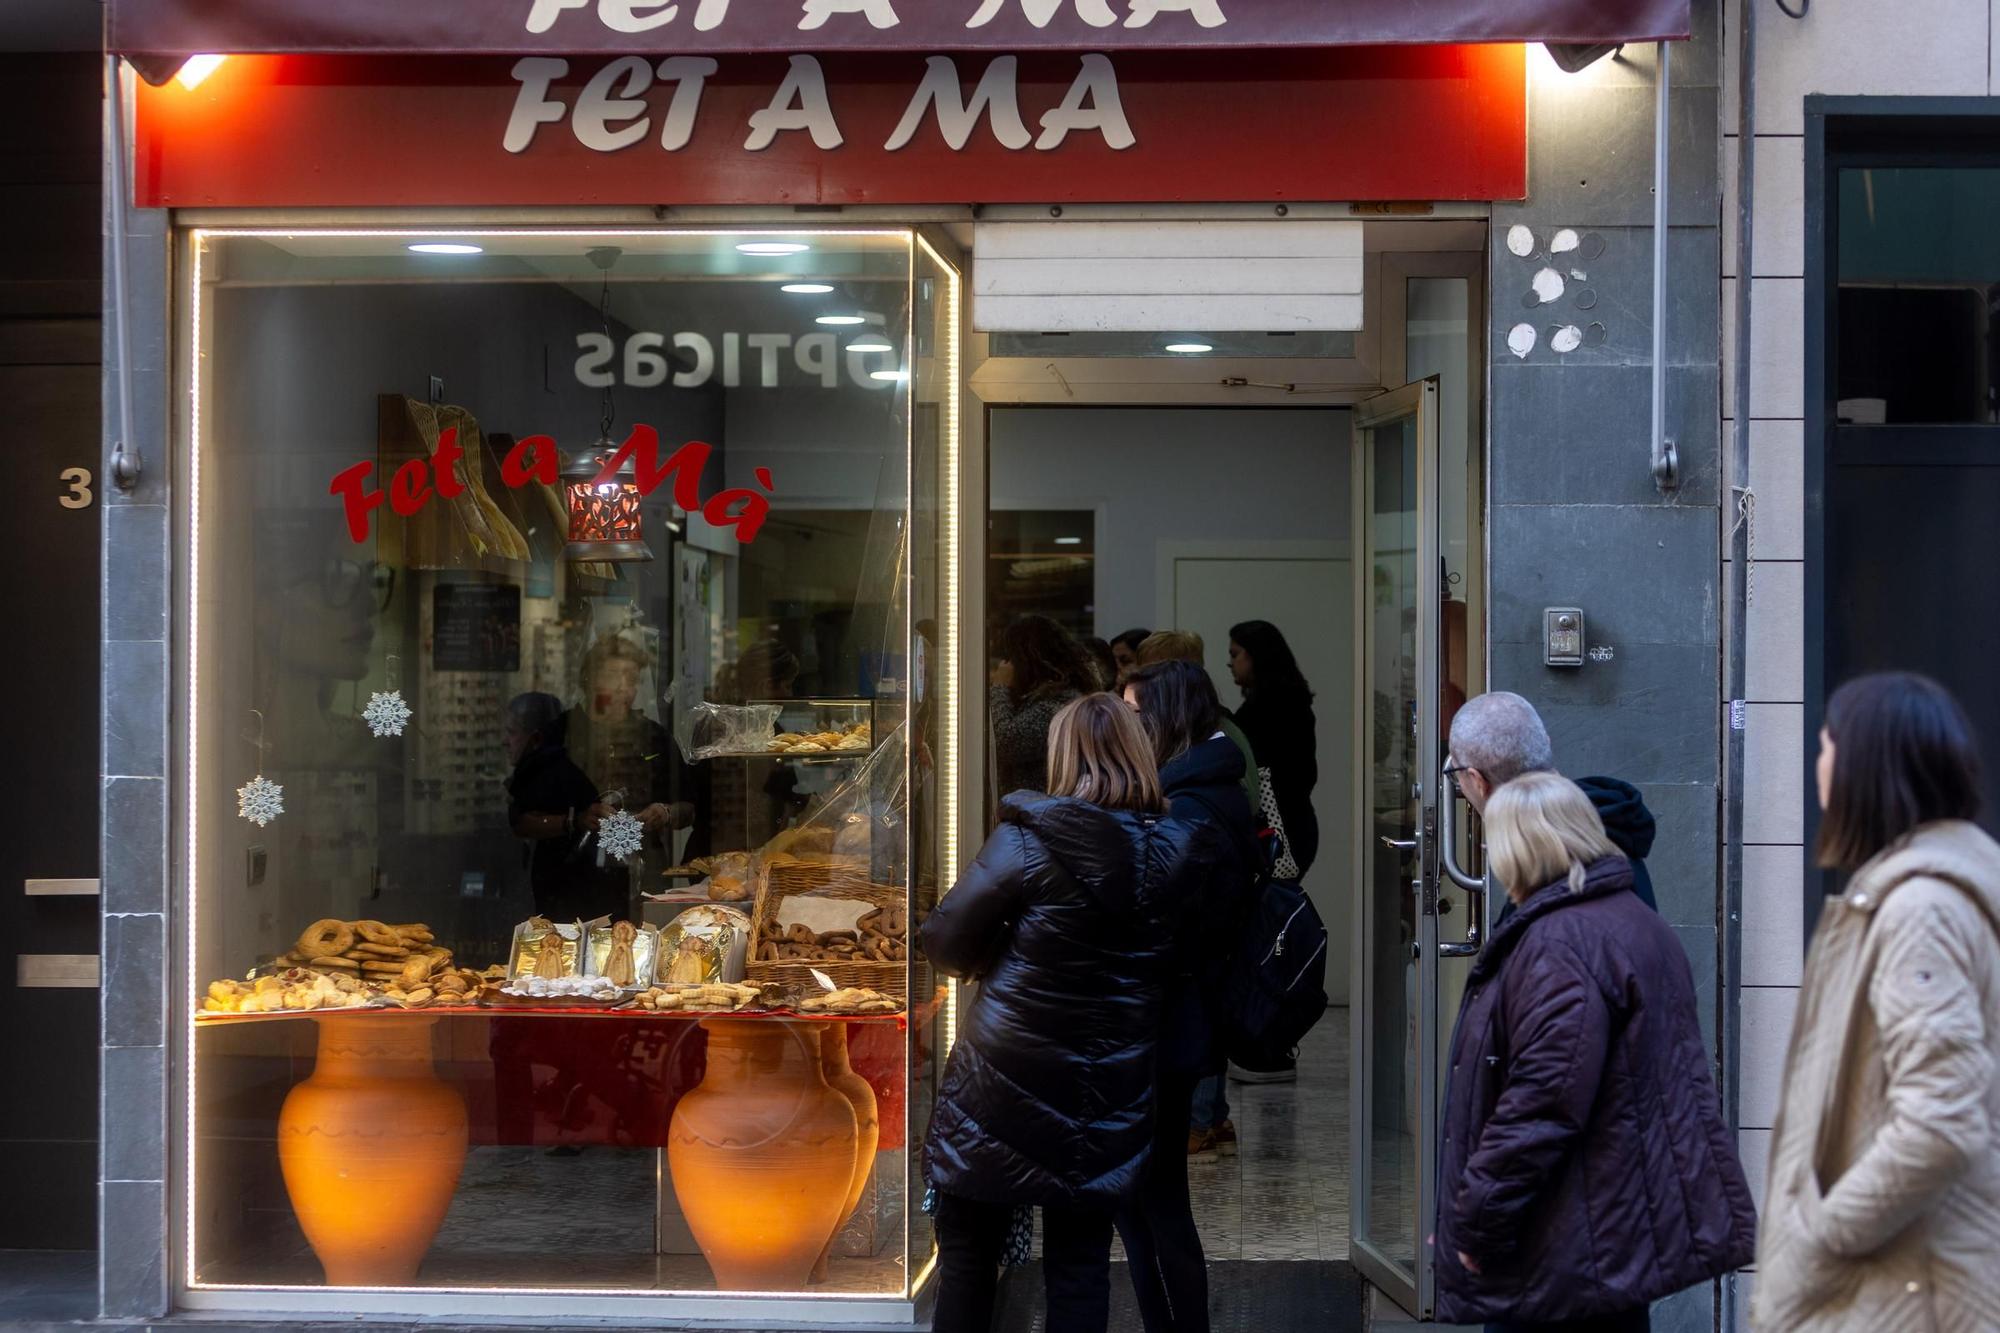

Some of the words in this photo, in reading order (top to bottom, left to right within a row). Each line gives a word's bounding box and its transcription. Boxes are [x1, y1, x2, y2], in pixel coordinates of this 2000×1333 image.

[744, 54, 844, 150] A
[884, 53, 1136, 151] MA
[59, 467, 93, 509] 3
[330, 427, 465, 543] Fet
[502, 434, 558, 488] a
[591, 423, 774, 543] Mà
